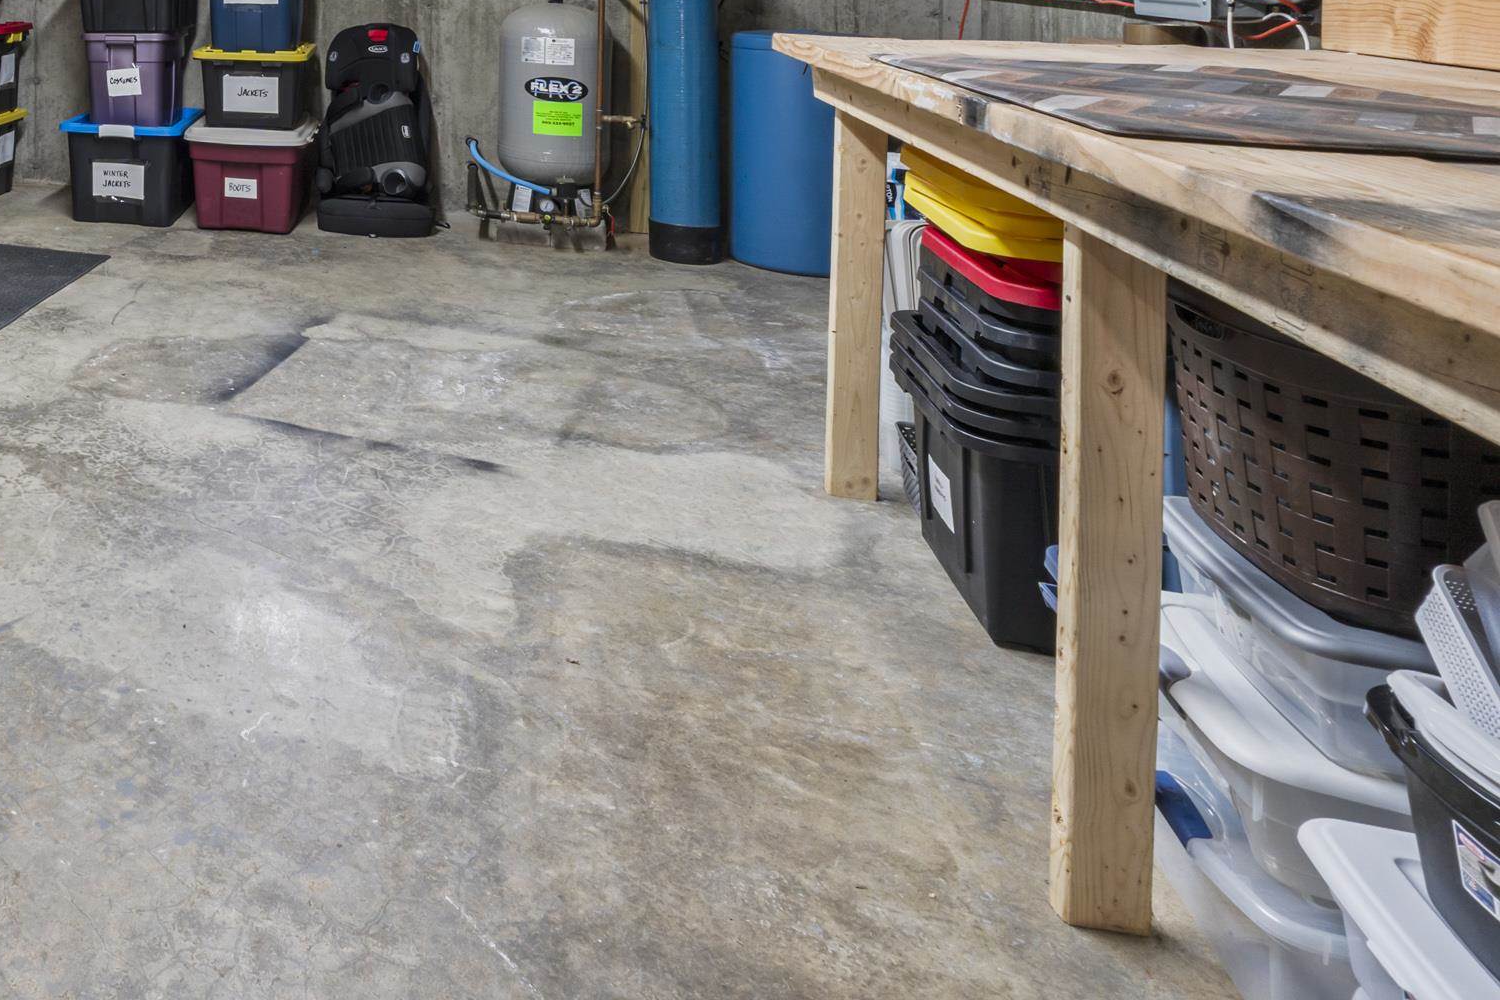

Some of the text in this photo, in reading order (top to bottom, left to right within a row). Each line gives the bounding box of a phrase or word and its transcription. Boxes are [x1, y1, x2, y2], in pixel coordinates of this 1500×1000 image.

[237, 86, 268, 98] JACKETS
[103, 170, 129, 178] WINTER
[102, 179, 131, 188] JACKETS
[228, 182, 252, 193] BOOTS
